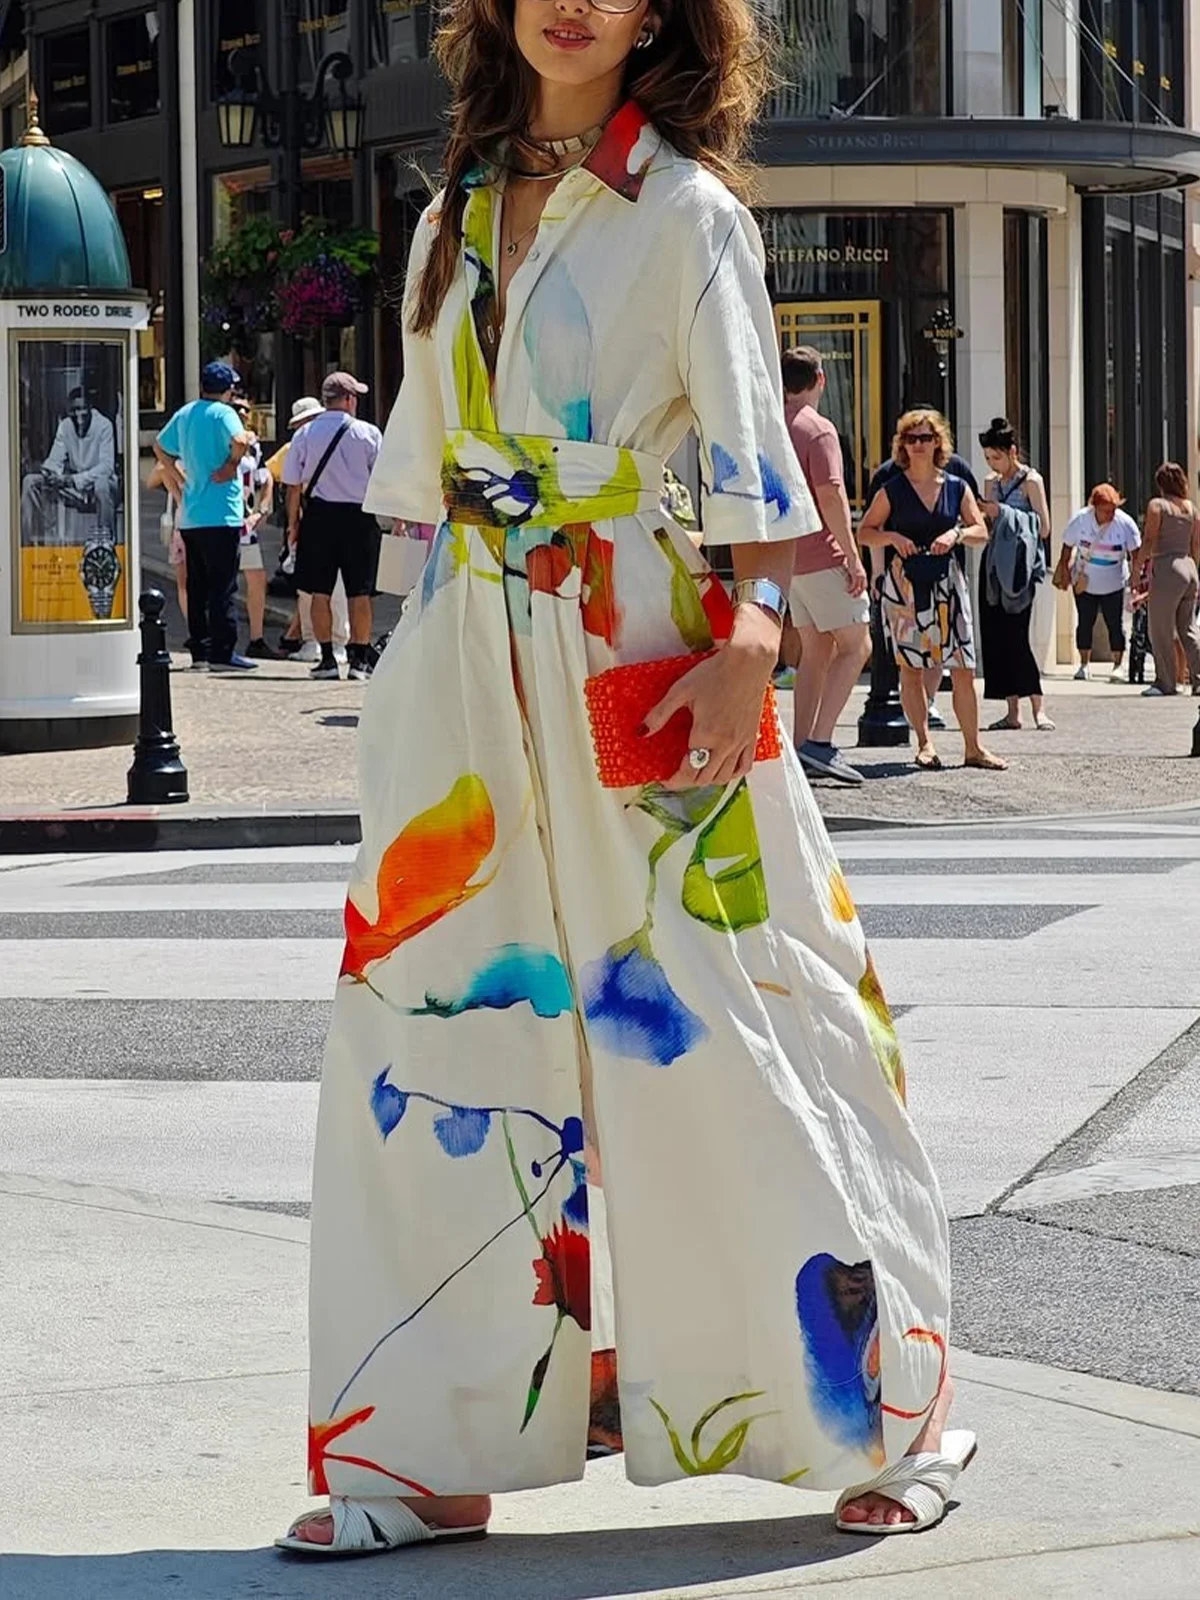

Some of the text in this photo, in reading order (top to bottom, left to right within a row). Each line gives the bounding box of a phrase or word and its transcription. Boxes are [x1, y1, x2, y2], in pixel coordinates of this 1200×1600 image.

[767, 246, 889, 262] STEFANO RICCI
[17, 305, 49, 317] TWO
[53, 304, 100, 317] RODEO
